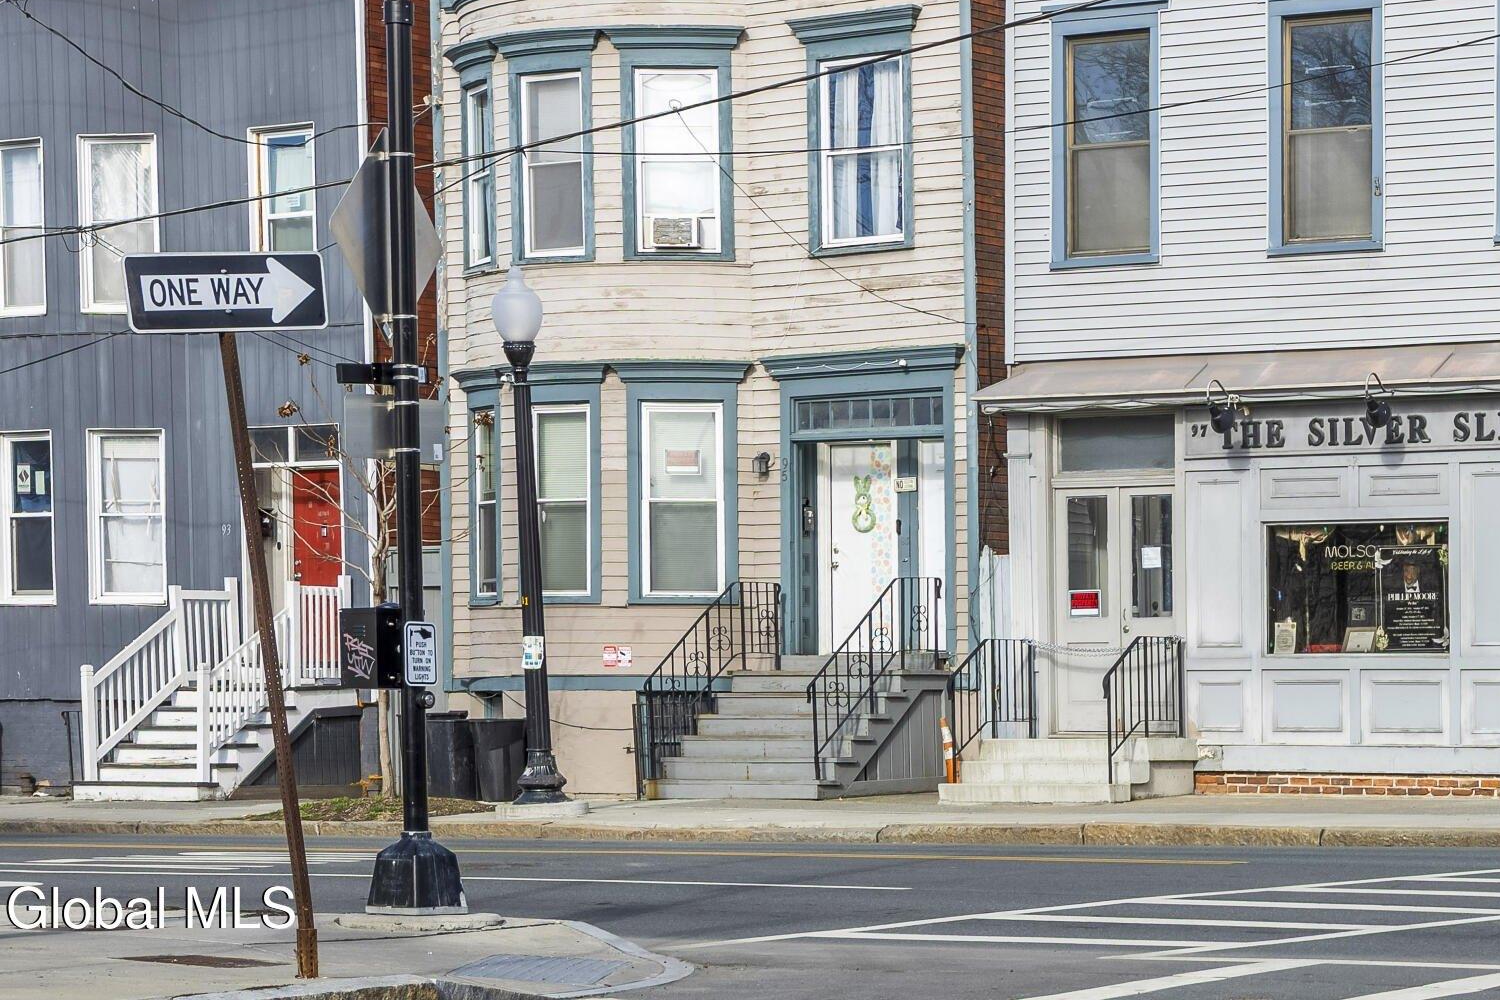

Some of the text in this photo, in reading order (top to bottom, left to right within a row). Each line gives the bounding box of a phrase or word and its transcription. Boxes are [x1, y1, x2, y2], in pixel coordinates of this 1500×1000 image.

[150, 277, 264, 307] ONE WAY
[1222, 419, 1286, 450] THE
[1308, 415, 1431, 447] SILVER
[221, 523, 231, 536] 93
[1324, 544, 1376, 558] MOLSO
[1331, 561, 1356, 570] BEER
[1365, 561, 1376, 570] AL
